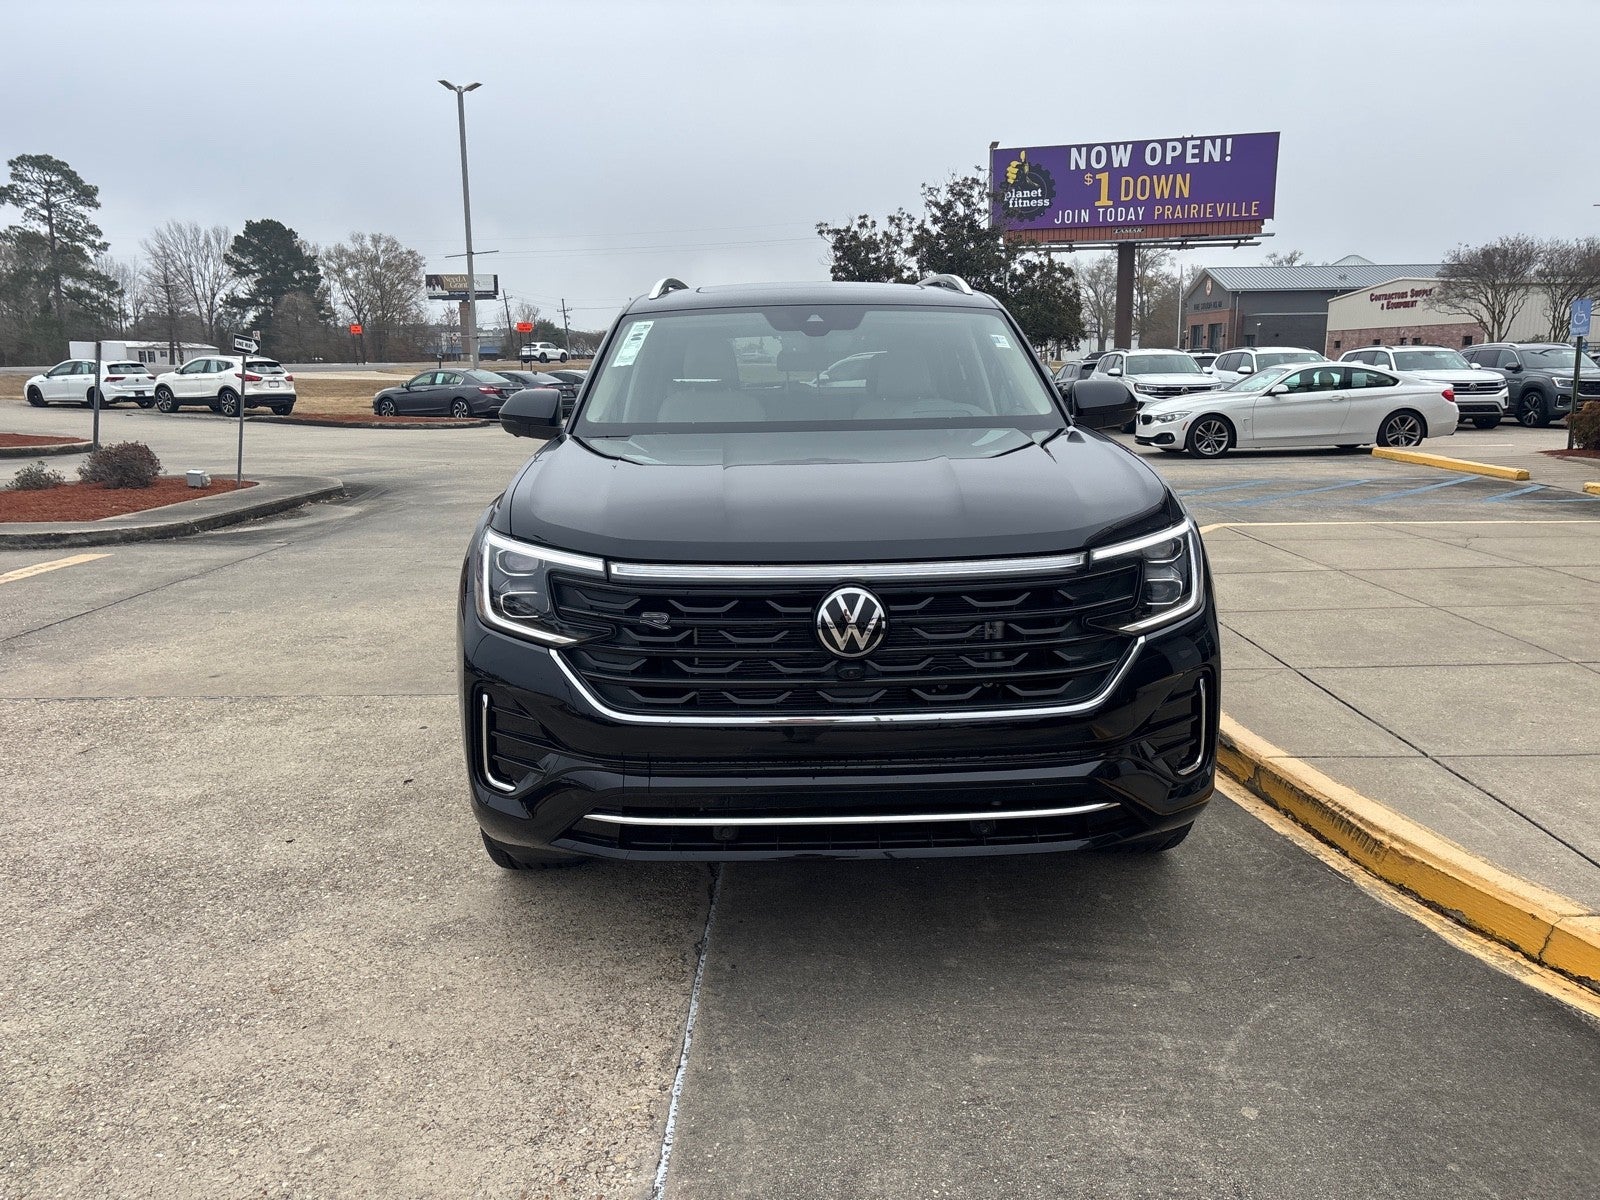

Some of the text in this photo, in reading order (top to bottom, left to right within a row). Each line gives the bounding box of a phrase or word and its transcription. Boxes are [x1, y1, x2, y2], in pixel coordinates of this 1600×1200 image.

[1070, 138, 1233, 171] NOW OPEN!
[1004, 188, 1042, 201] planet
[1009, 197, 1050, 208] fitness
[1084, 171, 1191, 207] $1 DOWN
[1054, 201, 1260, 224] JOIN TODAY PRAIRIEVILLE
[818, 589, 884, 655] VW
